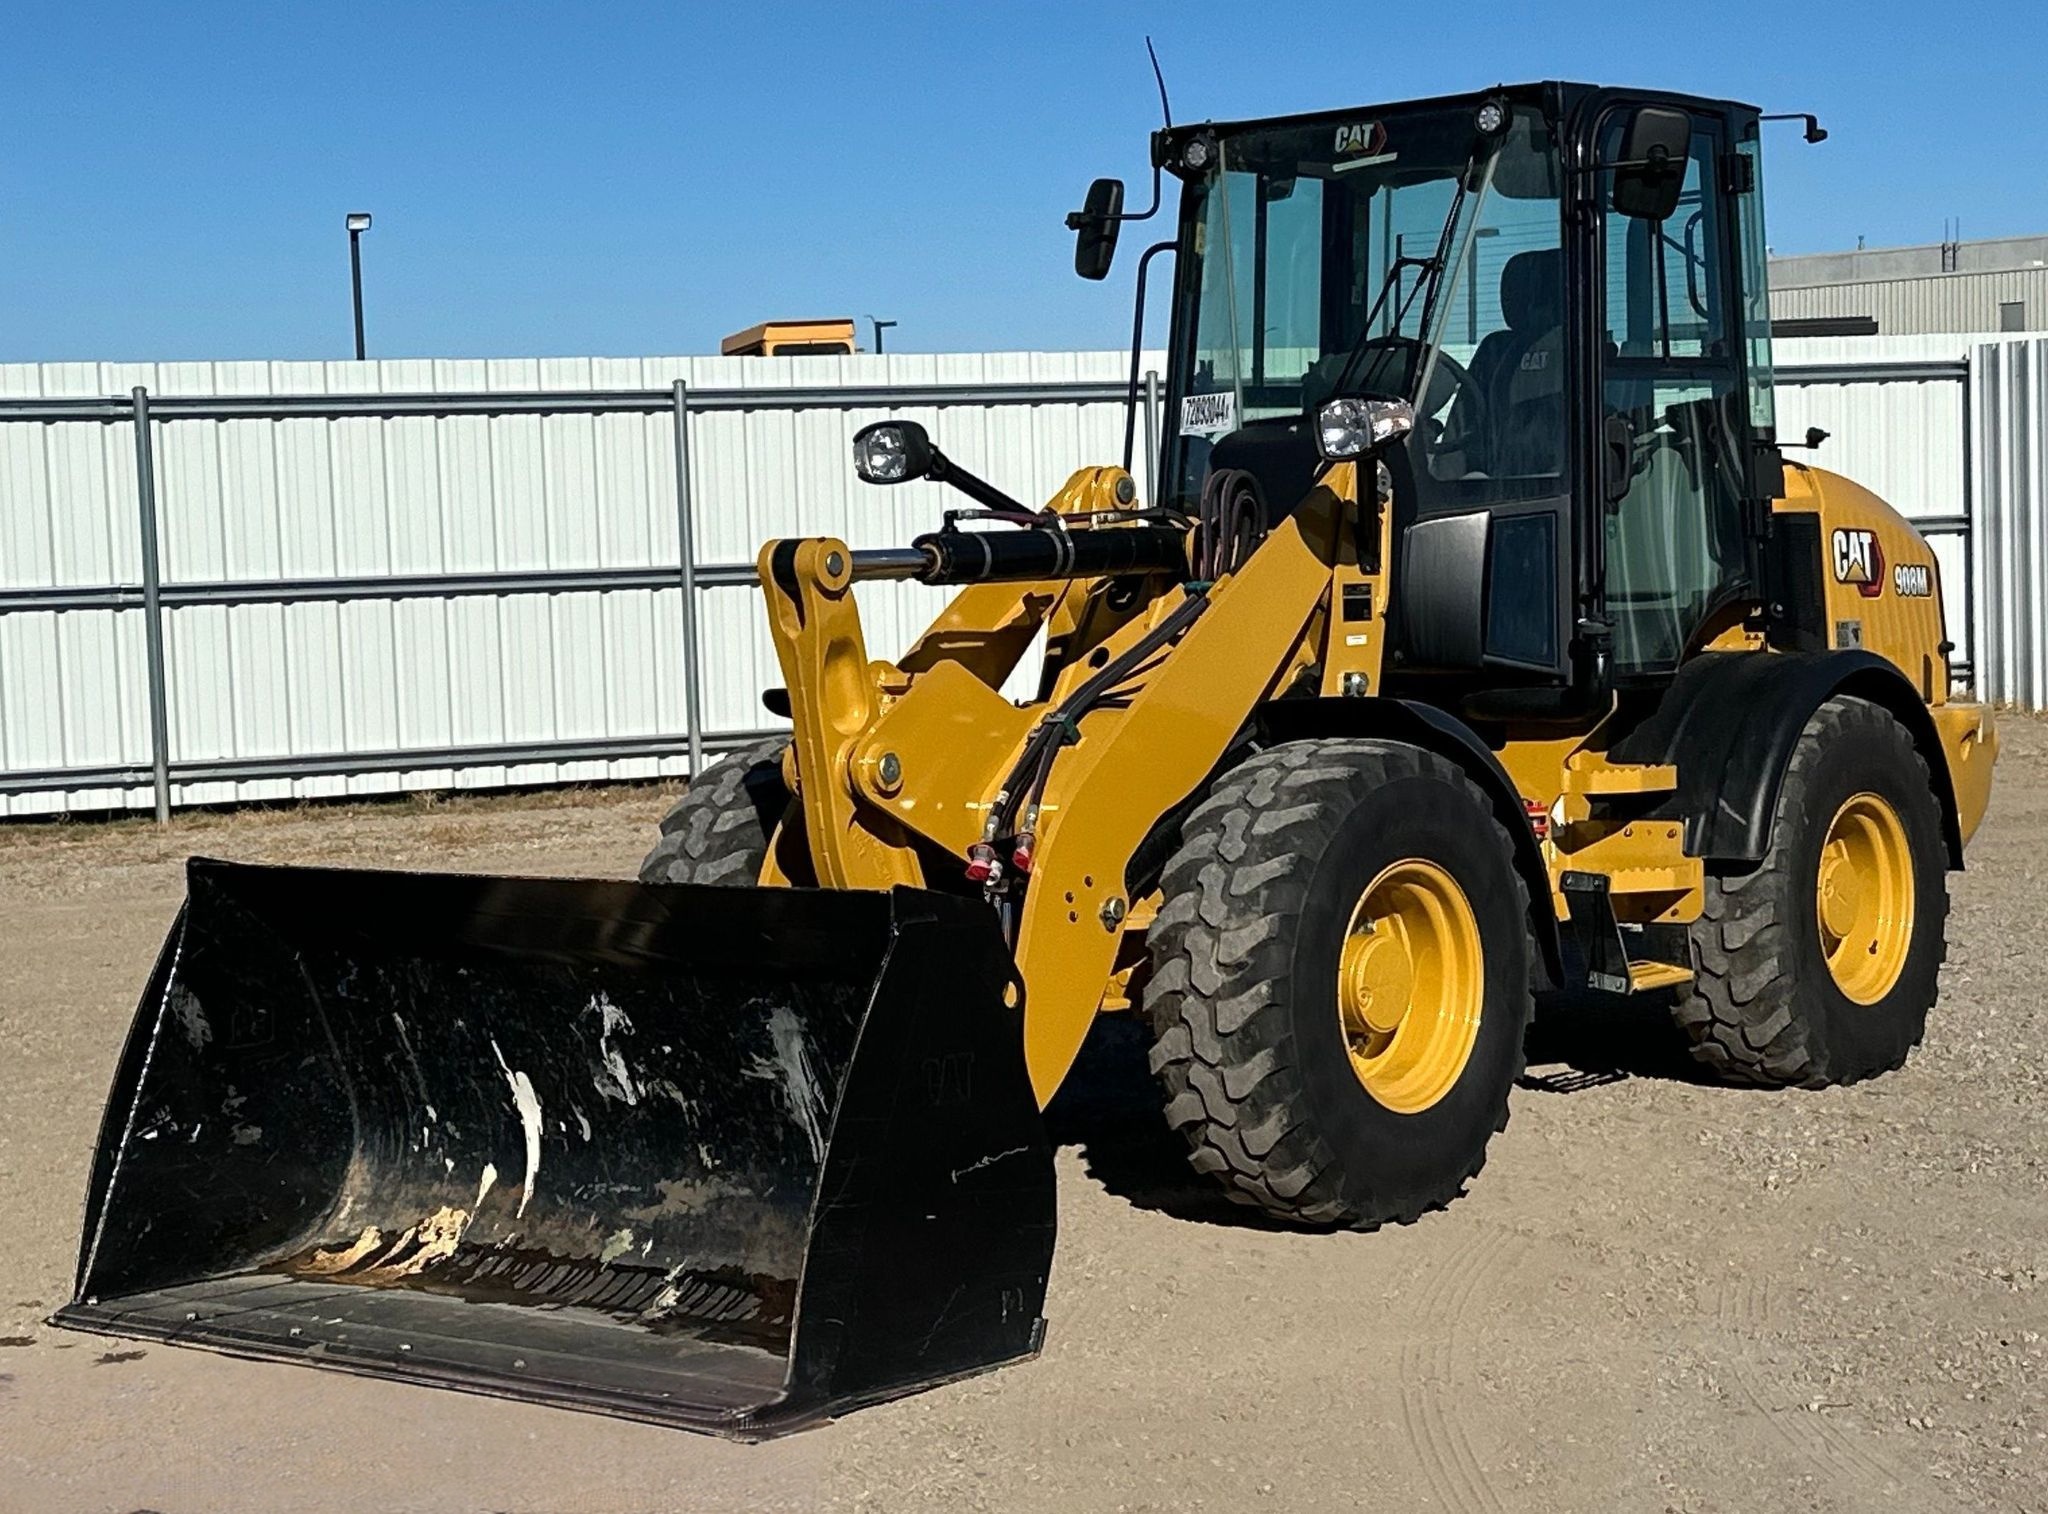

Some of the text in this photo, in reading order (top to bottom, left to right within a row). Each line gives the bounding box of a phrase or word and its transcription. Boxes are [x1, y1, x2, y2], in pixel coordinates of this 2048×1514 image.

[1335, 123, 1374, 153] CAT
[1520, 351, 1549, 370] CAT
[1833, 530, 1872, 581] CAT
[1894, 565, 1928, 595] 908M
